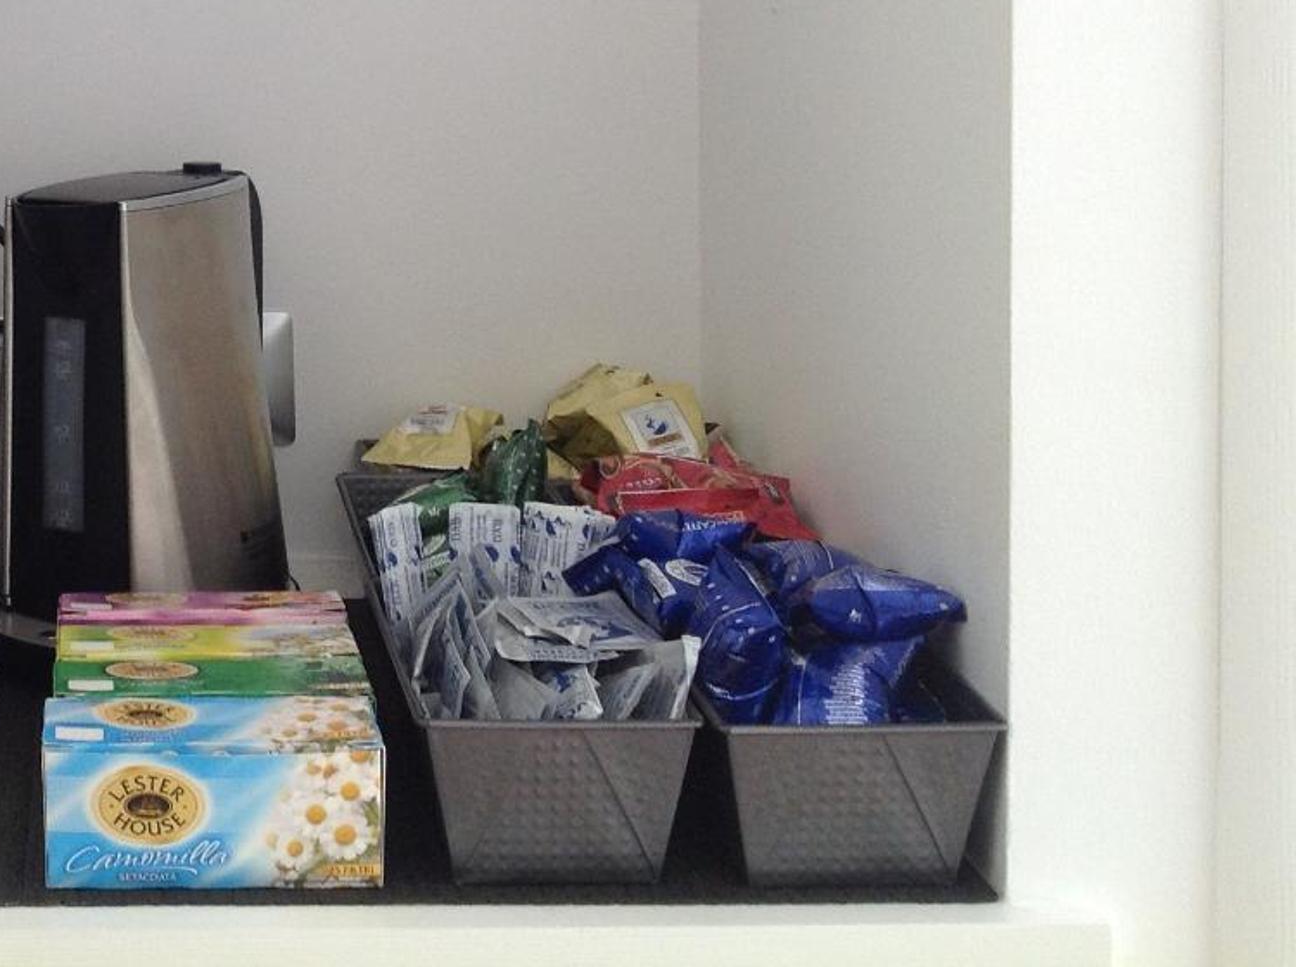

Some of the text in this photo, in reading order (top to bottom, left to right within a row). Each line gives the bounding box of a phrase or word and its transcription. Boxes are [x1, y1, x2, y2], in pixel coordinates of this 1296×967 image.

[108, 775, 184, 802] LESTER
[114, 812, 186, 836] HOUSE
[65, 840, 229, 875] Camomilla
